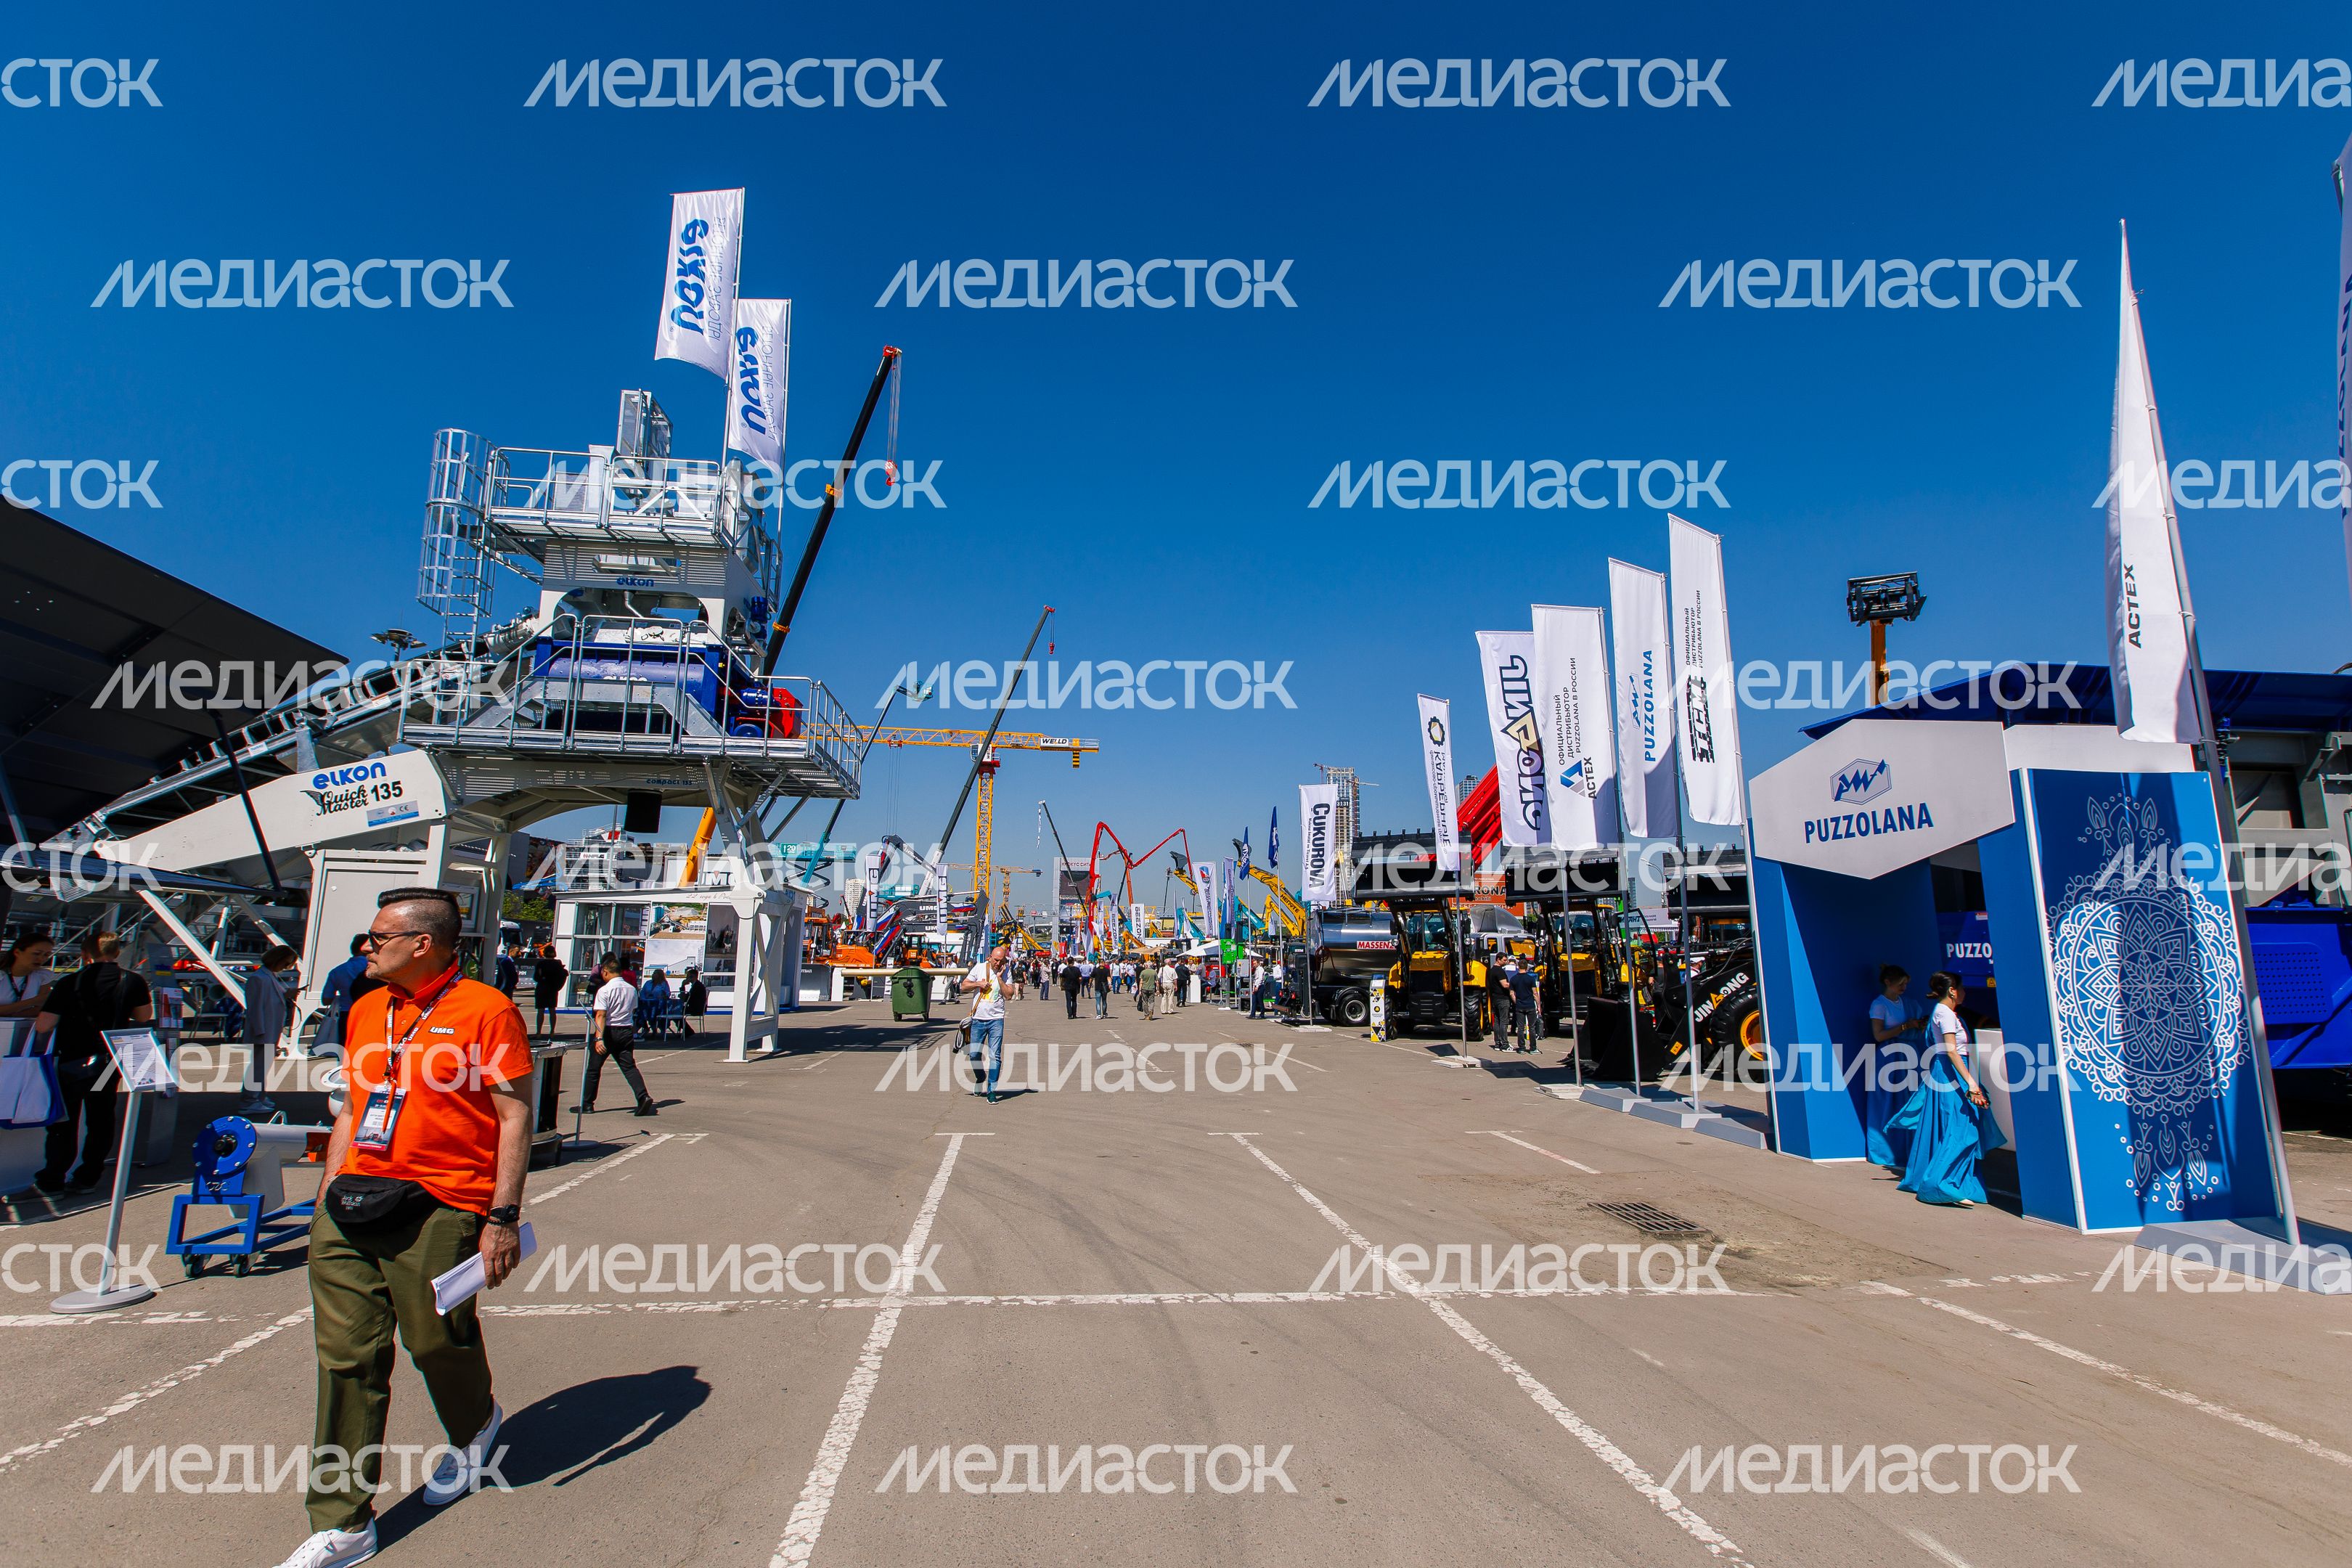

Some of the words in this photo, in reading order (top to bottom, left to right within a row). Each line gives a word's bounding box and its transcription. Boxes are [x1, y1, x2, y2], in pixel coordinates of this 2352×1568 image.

[1563, 687, 1575, 759] ДИСТРИБЬЮТОР
[1643, 650, 1656, 762] PUZZOLANA
[1553, 695, 1565, 765] ОФИЦИАЛЬНЫЙ
[317, 798, 369, 816] Master
[321, 785, 368, 805] Quick
[370, 780, 404, 802] 135
[1804, 802, 1934, 844] PUZZOLANA
[1309, 803, 1331, 889] ÇUKUROVA
[1475, 886, 1506, 896] RONA
[1946, 943, 1993, 958] PUZZO
